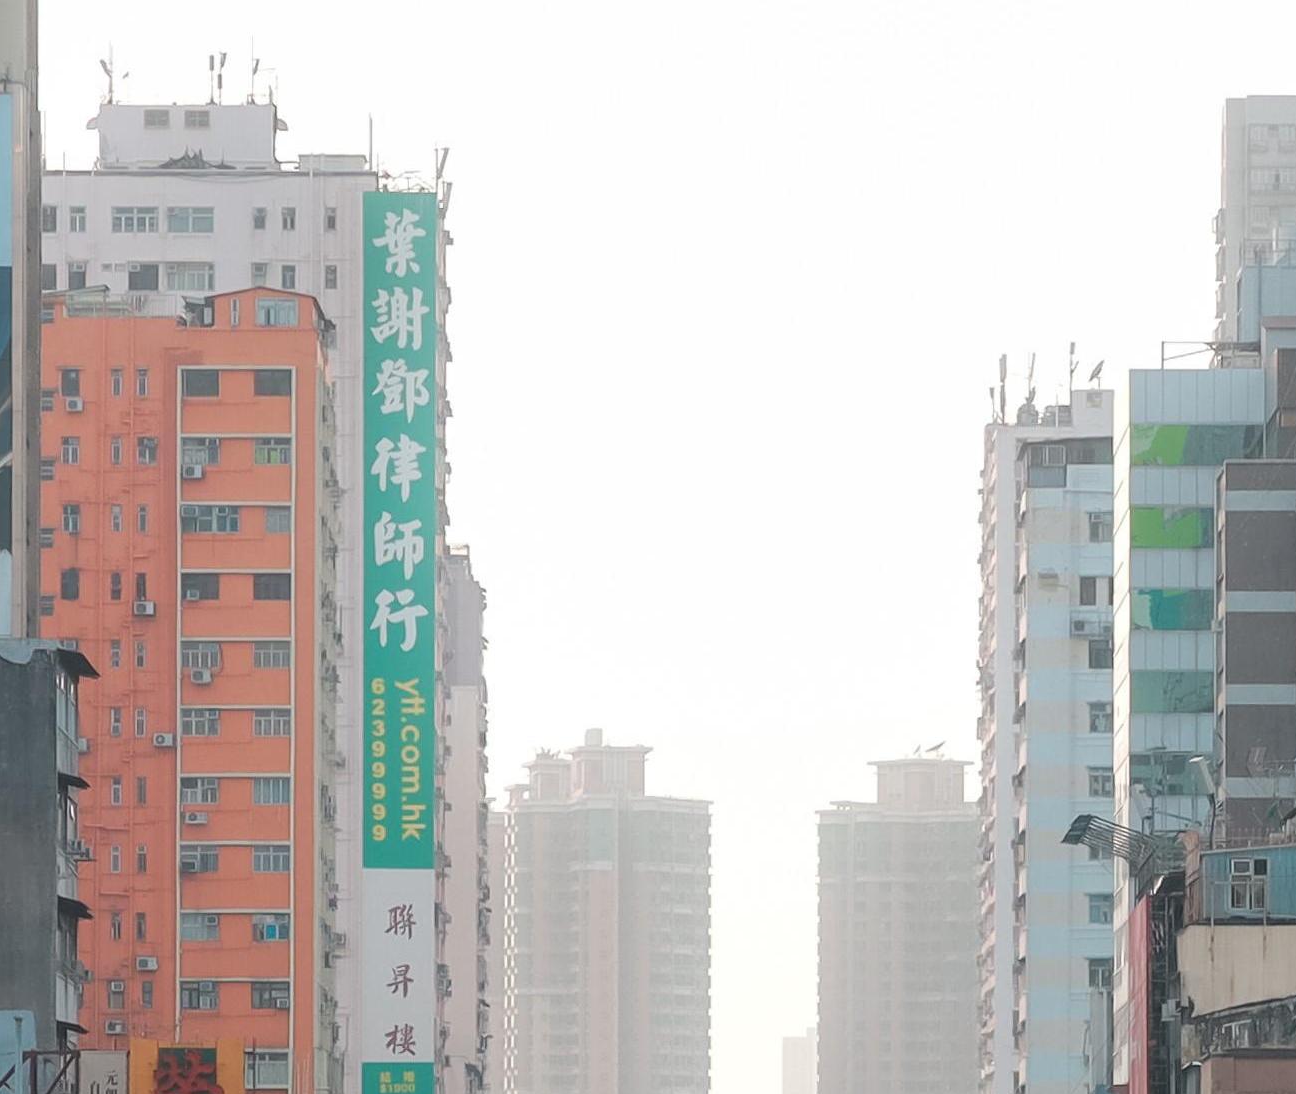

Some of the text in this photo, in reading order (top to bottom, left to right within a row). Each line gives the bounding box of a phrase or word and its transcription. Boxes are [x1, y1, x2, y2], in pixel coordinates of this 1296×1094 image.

[370, 208, 430, 652] 葉謝鄧律師行
